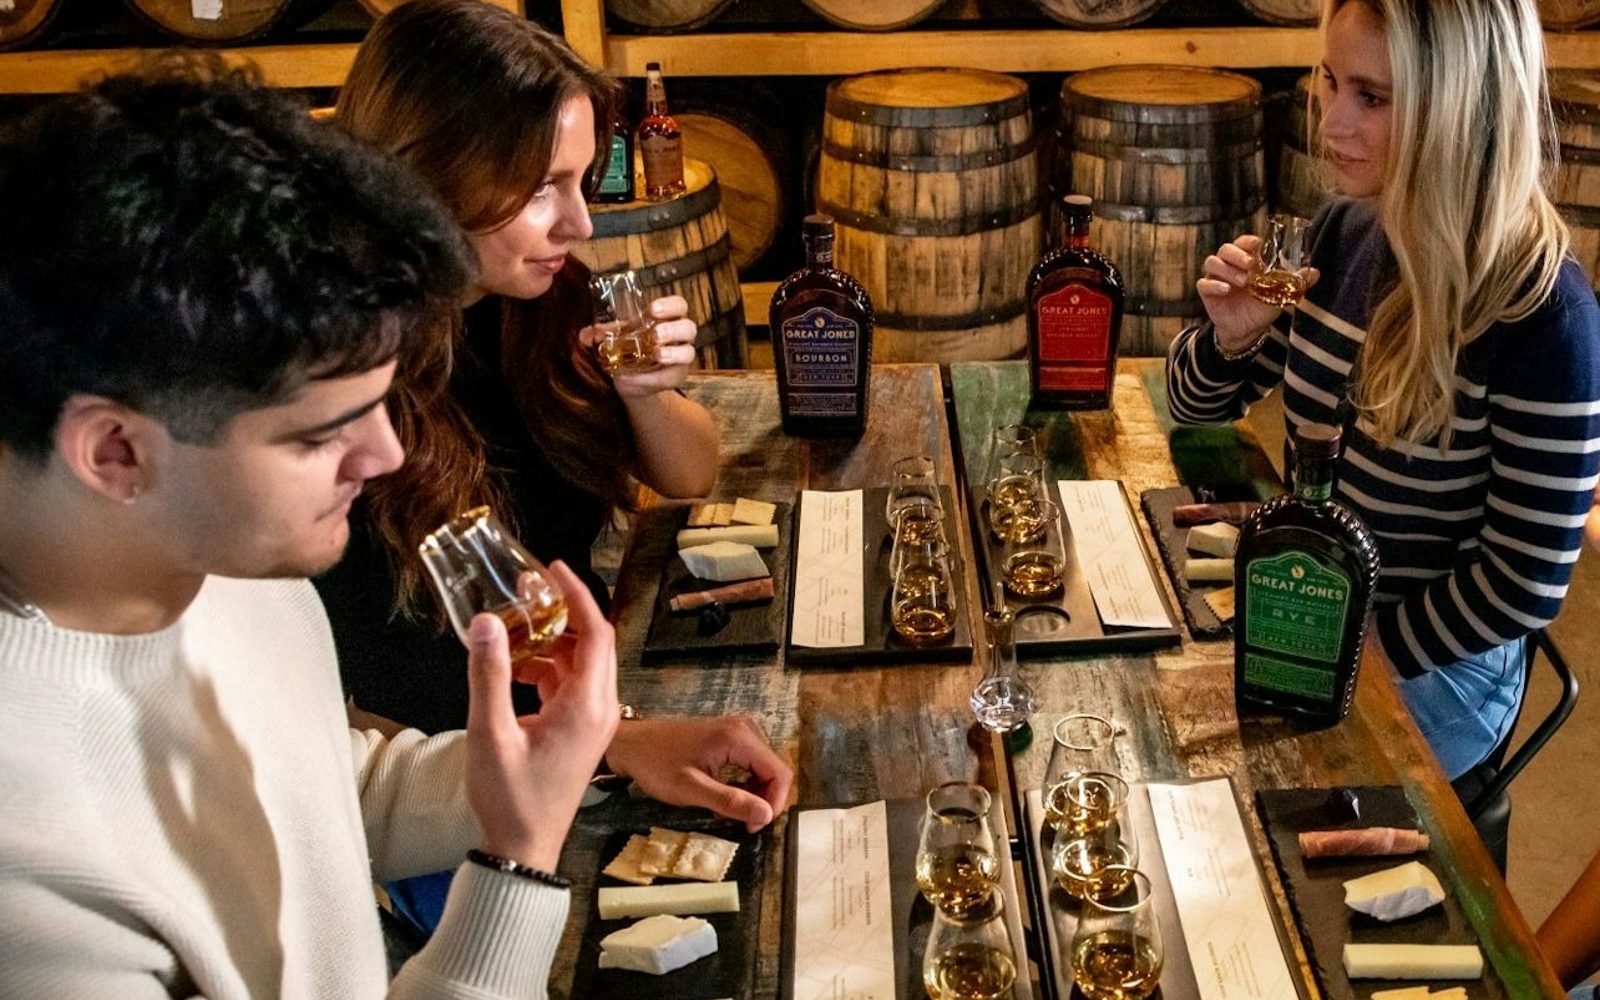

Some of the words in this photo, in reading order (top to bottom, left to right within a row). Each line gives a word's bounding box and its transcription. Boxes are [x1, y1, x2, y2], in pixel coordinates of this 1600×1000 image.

[1041, 306, 1074, 315] GREAT
[1077, 306, 1108, 315] JONES
[785, 329, 819, 339] GREAT
[821, 329, 856, 339] JONES
[795, 353, 847, 363] BOURBON
[1250, 573, 1297, 592] GREAT
[1298, 584, 1345, 601] JONES
[1271, 607, 1317, 626] RYE
